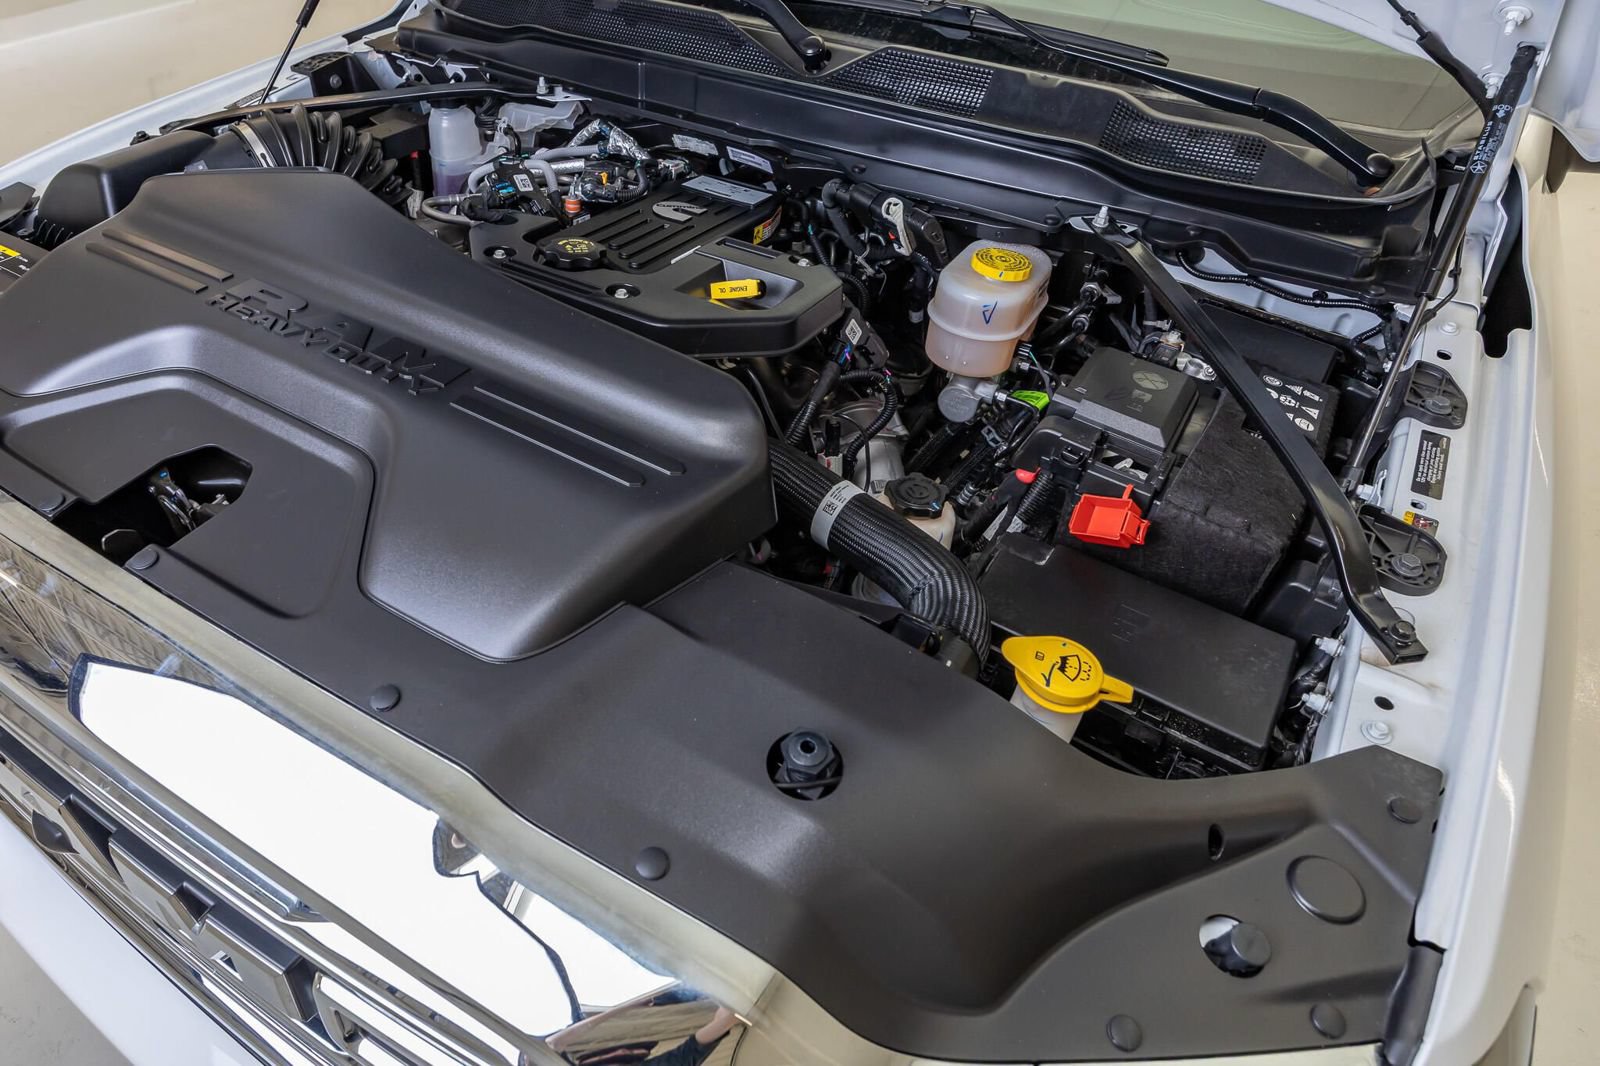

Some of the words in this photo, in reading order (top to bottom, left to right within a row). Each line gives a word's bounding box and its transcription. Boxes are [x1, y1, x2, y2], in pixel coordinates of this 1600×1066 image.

[1492, 104, 1514, 112] BODY
[1473, 120, 1493, 161] STABILUS
[729, 285, 748, 293] ENGINE
[207, 292, 330, 347] HEAVY
[226, 278, 472, 388] RAM
